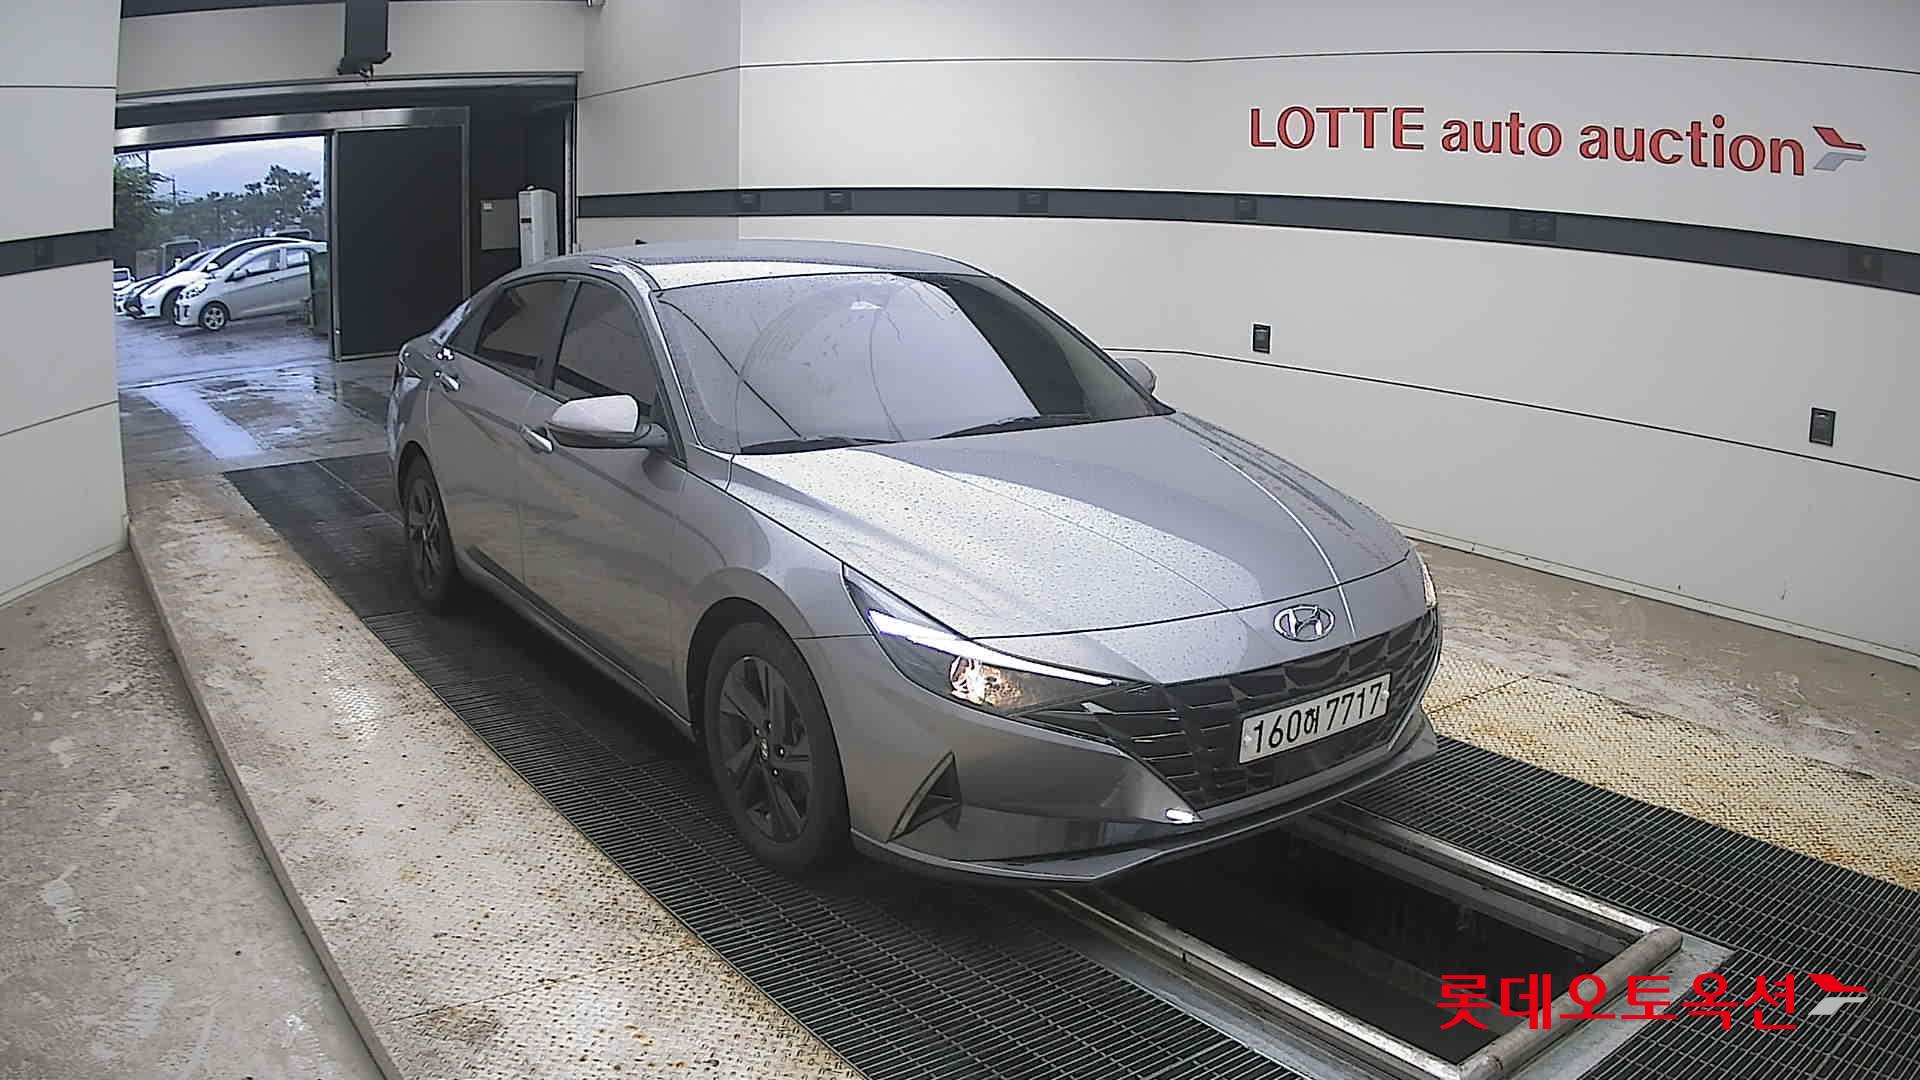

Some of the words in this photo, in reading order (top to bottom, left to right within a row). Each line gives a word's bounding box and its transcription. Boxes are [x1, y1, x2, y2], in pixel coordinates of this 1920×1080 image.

[1249, 105, 1425, 151] LOTTE
[1440, 111, 1563, 157] auto
[1578, 114, 1806, 176] auction
